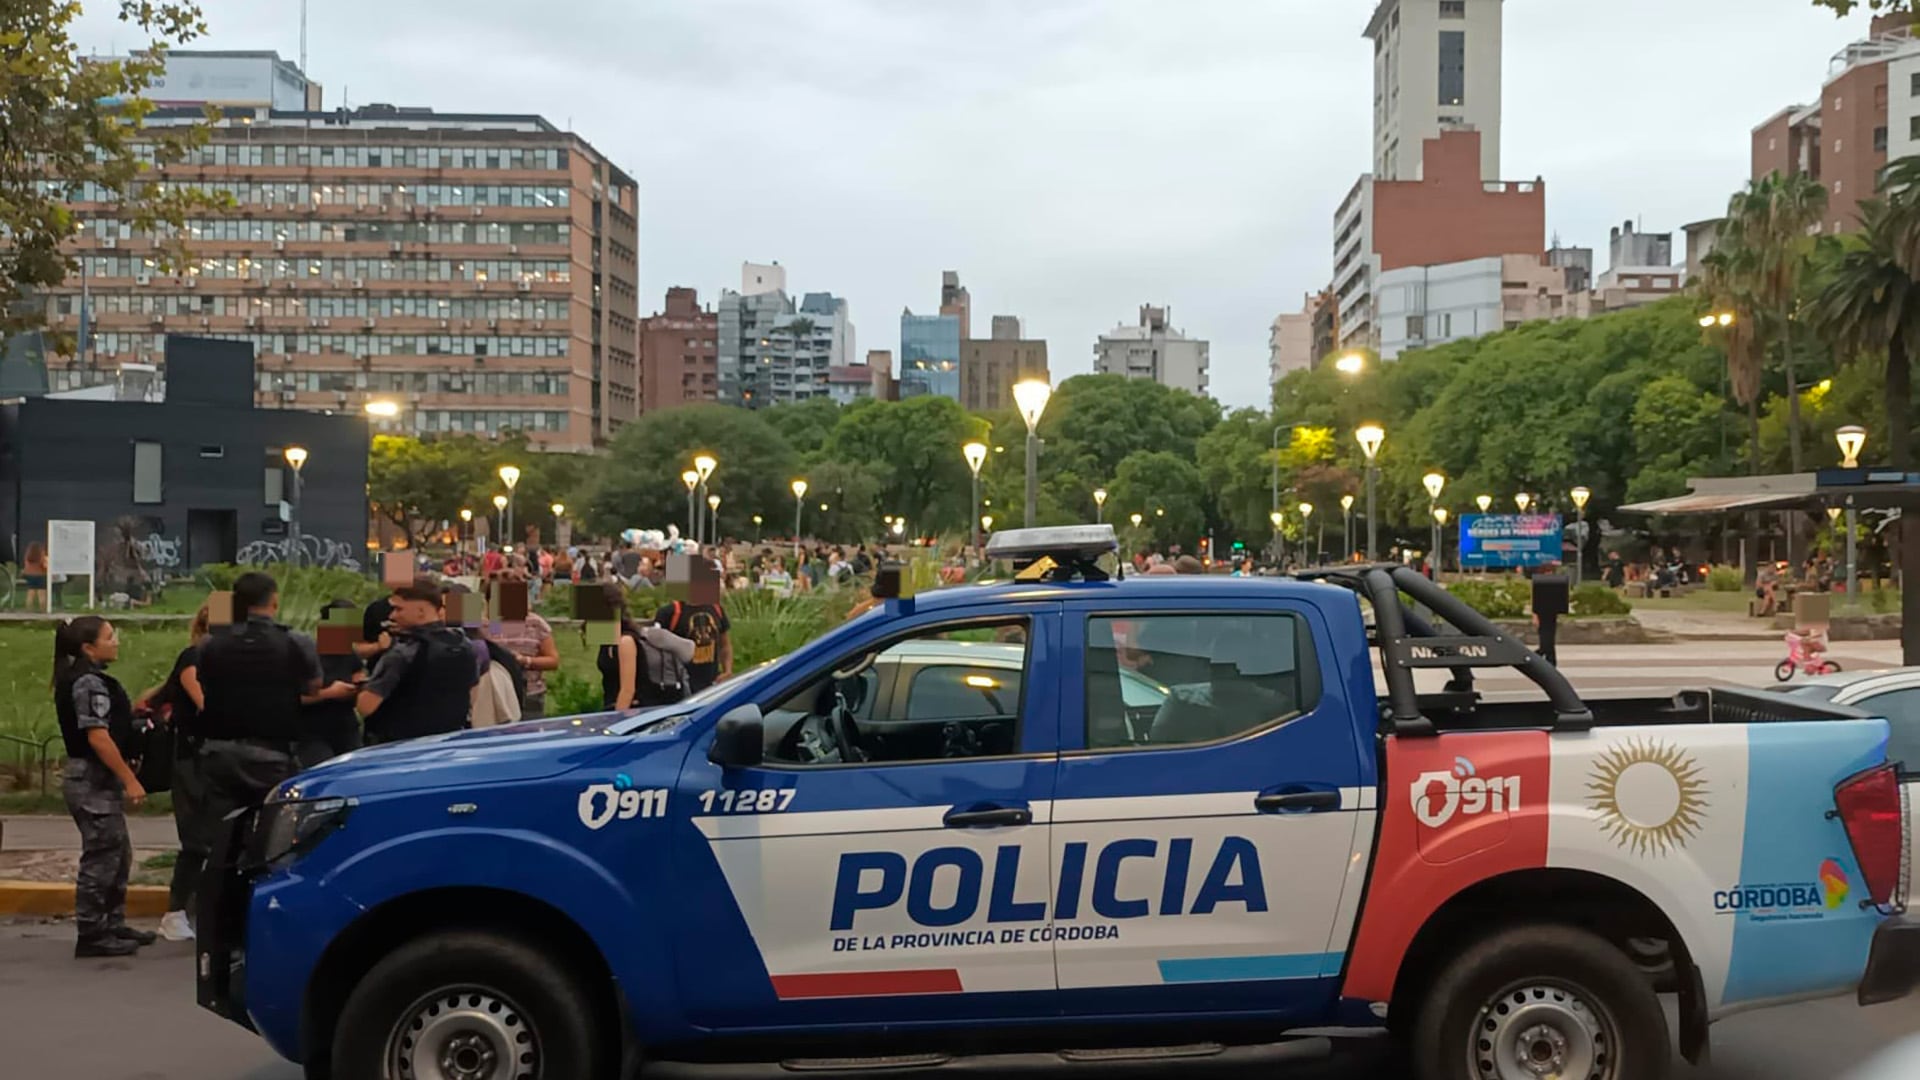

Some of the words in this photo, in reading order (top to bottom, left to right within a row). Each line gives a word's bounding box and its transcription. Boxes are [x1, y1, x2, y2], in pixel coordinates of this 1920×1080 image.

[619, 789, 668, 819] 911
[699, 789, 796, 813] 11287
[1461, 776, 1520, 814] 911
[829, 836, 1268, 930] POLICIA
[1714, 885, 1822, 909] CÓRDOBA
[833, 937, 857, 952] DE
[862, 934, 886, 950] LA
[891, 931, 995, 949] PROVINCIA
[1000, 928, 1026, 943] DE
[1029, 924, 1119, 942] CÓRDOBA
